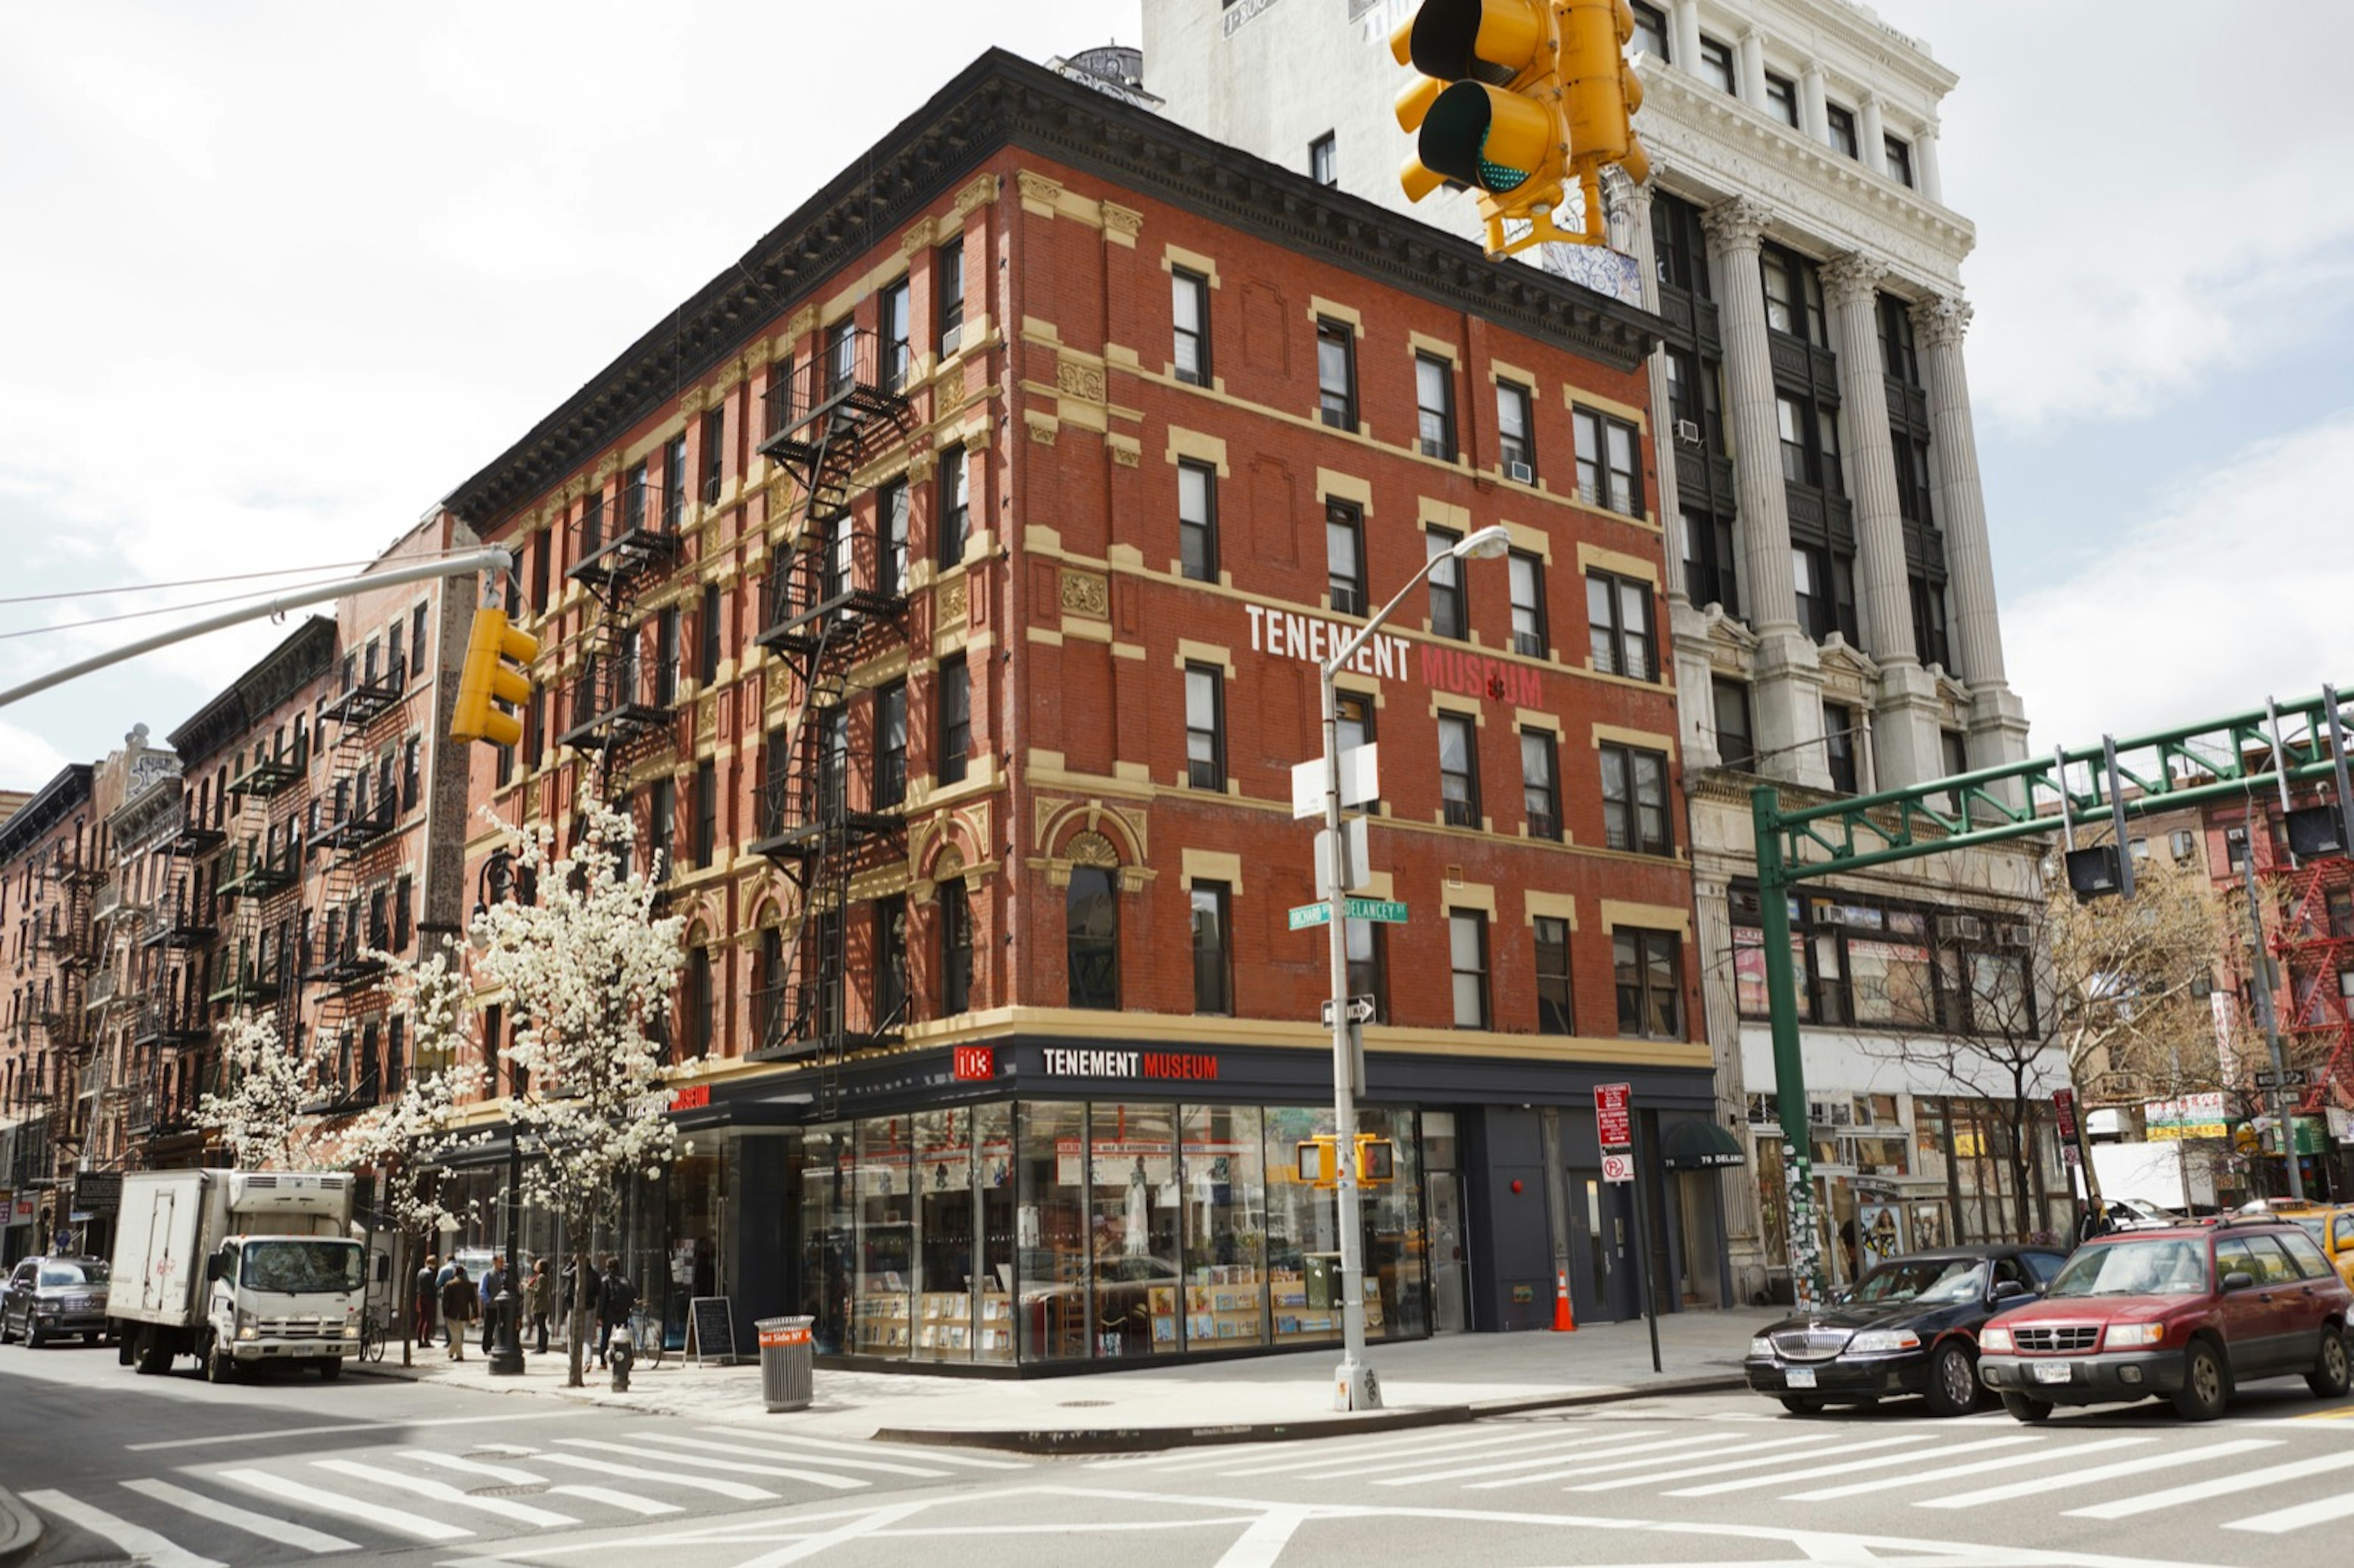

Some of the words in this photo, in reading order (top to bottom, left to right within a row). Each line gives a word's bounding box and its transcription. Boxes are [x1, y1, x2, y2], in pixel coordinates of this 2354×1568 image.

[1245, 604, 1410, 682] TENEMENT
[1421, 644, 1543, 708] MUSEUM
[1290, 906, 1322, 929] ORCHARD
[1345, 901, 1393, 919] DELANCEY
[1043, 1049, 1138, 1078] TENEMENT
[1143, 1052, 1218, 1079] MUSEUM
